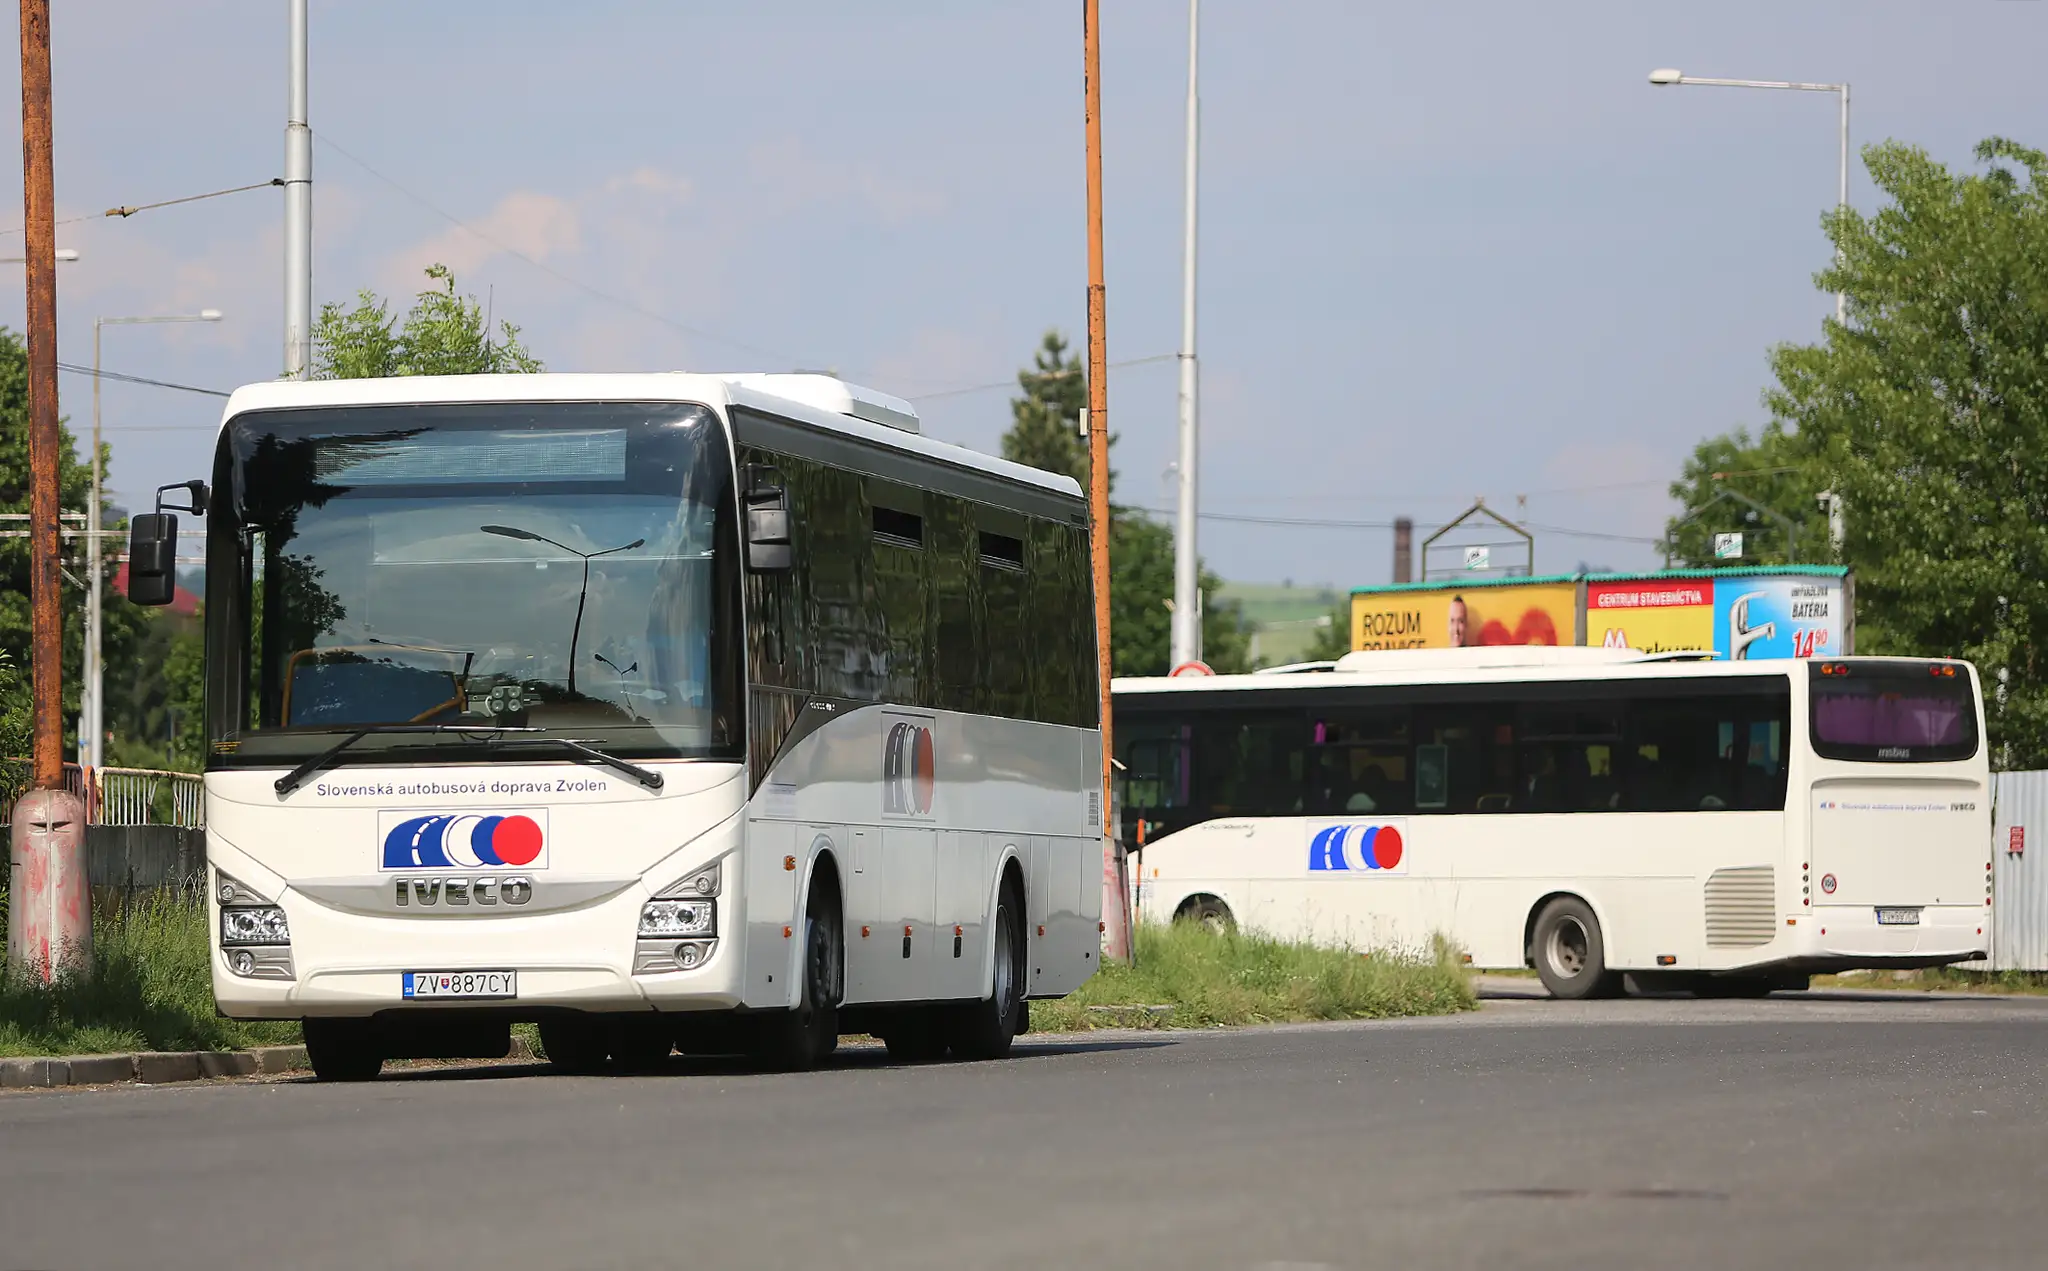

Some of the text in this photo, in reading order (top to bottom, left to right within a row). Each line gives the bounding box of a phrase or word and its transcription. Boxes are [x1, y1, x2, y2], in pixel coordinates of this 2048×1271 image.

[1598, 592, 1639, 607] CENTRUM
[1792, 601, 1828, 617] BATÉRIA
[1363, 611, 1421, 636] ROZUM
[316, 779, 608, 797] Slovenská autobusová doprava Zvolen
[396, 877, 532, 907] IVECO
[416, 975, 440, 994] ZV
[451, 974, 512, 993] 887CY
